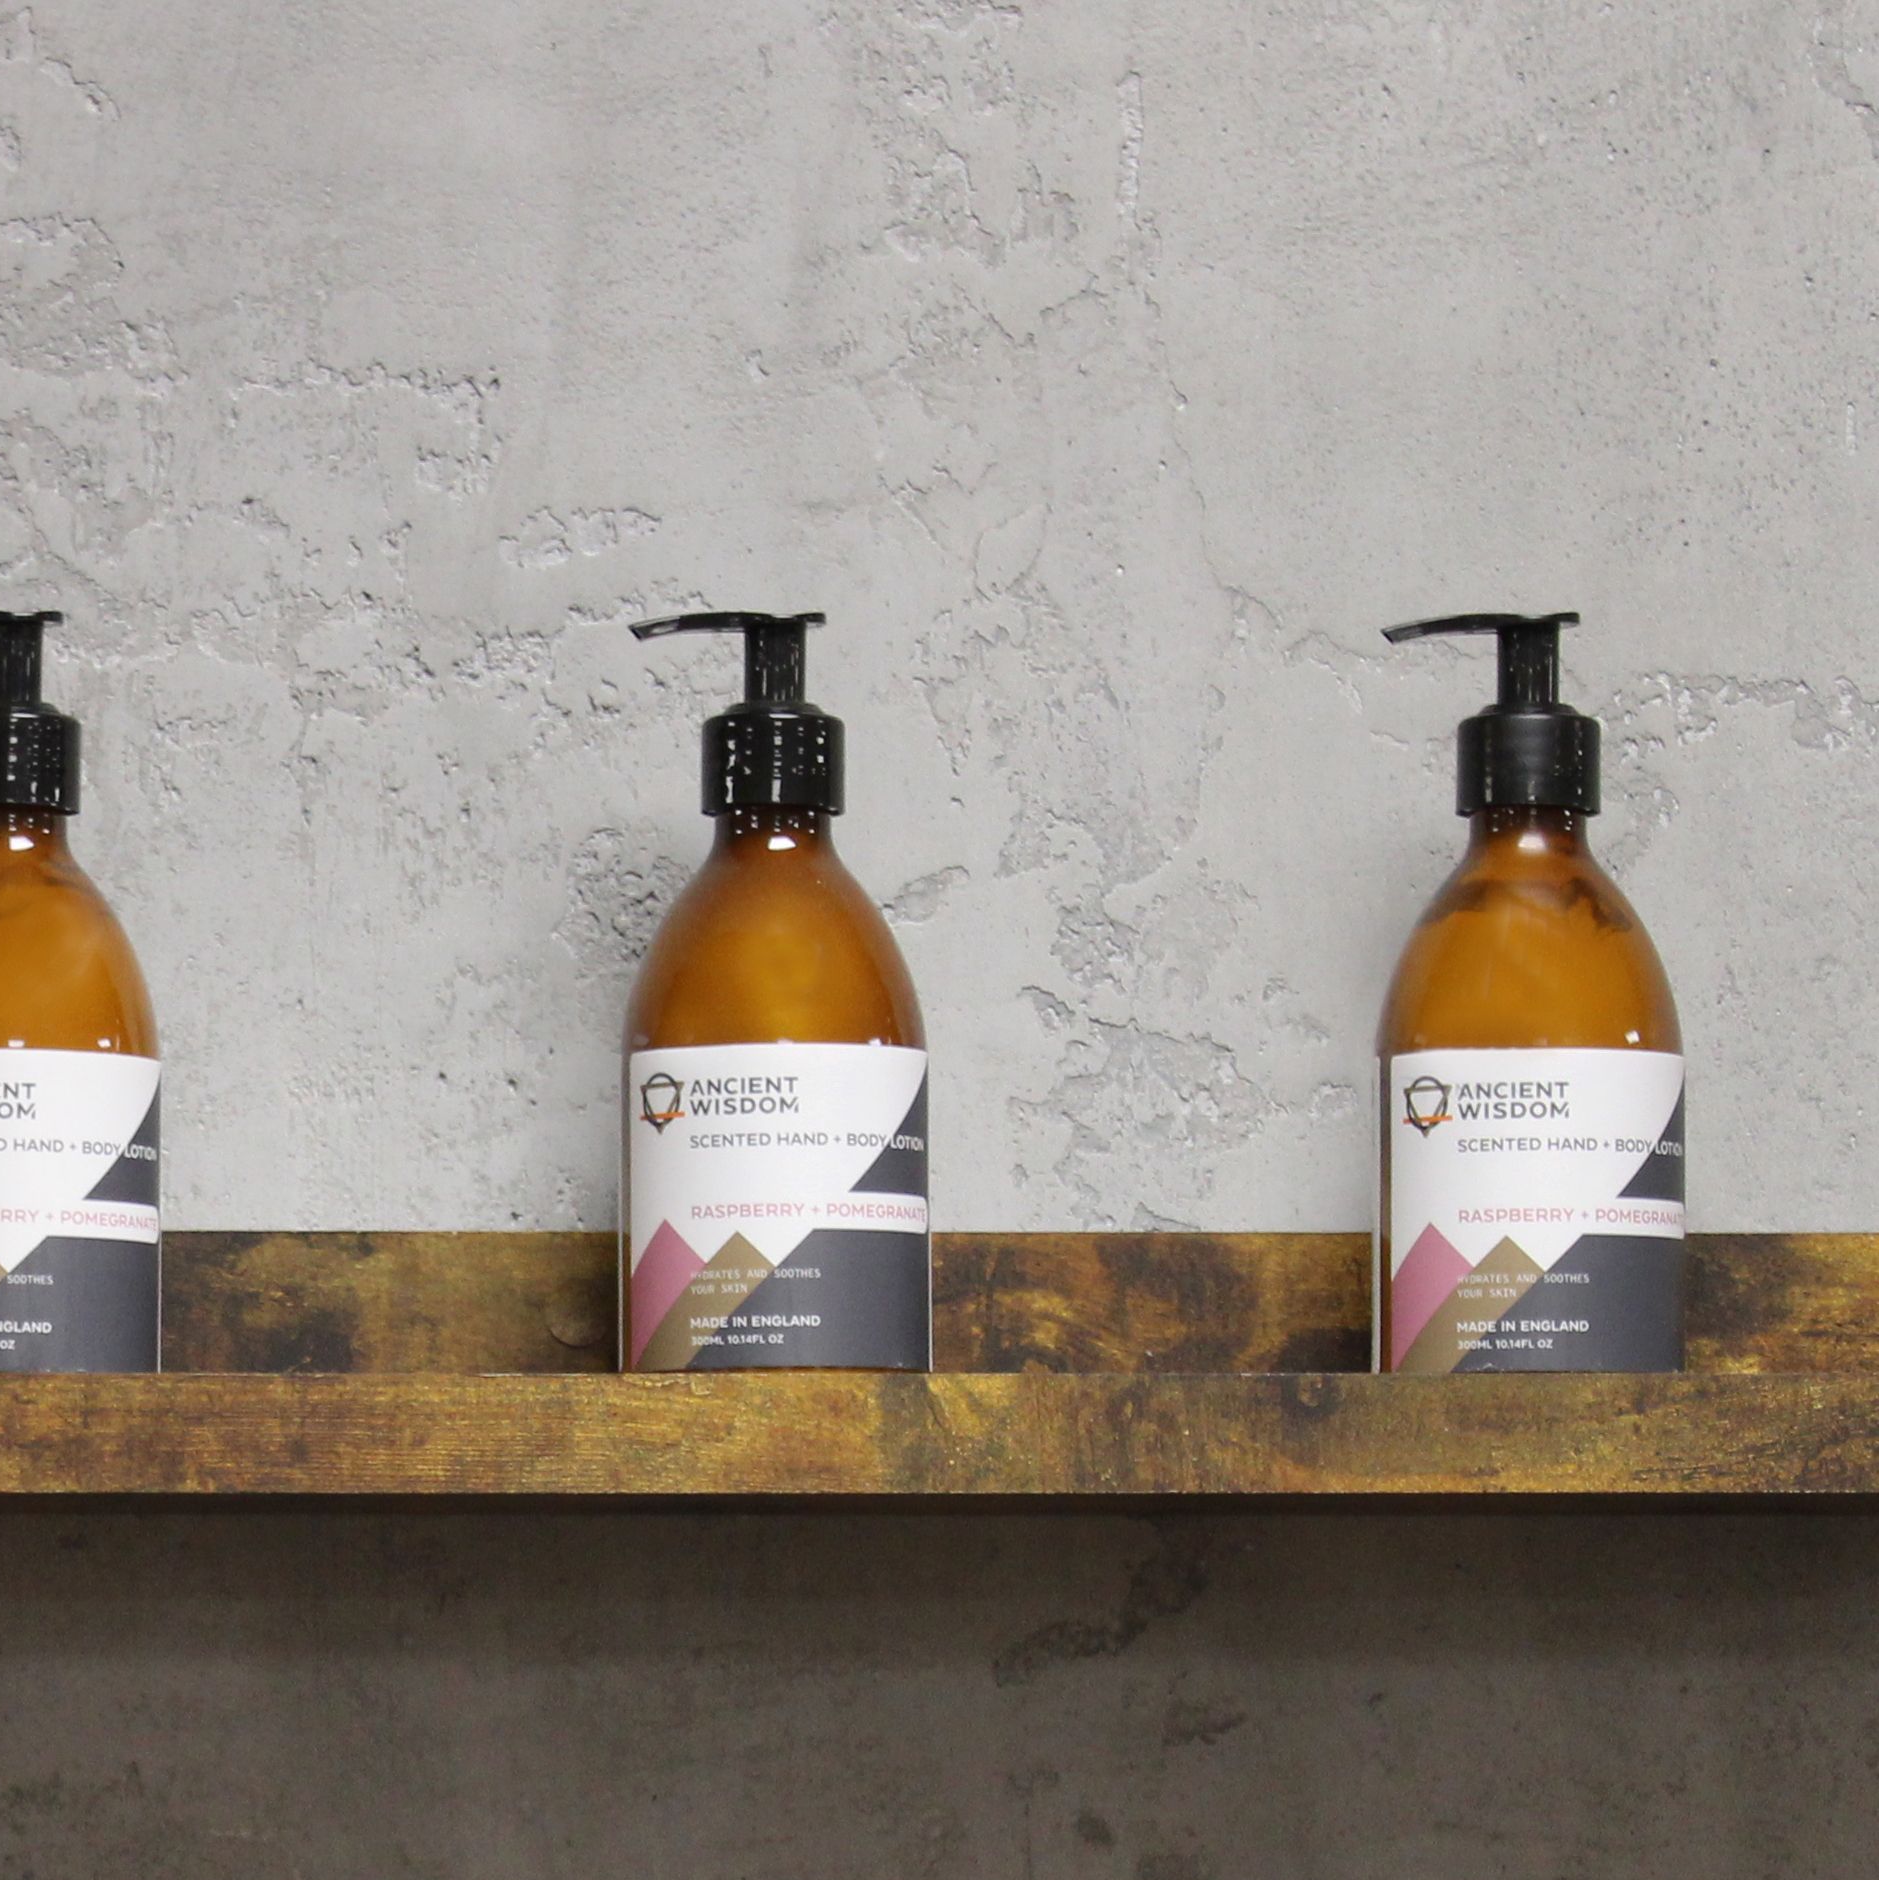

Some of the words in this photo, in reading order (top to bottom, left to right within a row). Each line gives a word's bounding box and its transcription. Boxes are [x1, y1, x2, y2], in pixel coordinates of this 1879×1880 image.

[691, 1077, 799, 1095] ANCIENT
[1458, 1082, 1569, 1100] ANCIENT
[691, 1097, 799, 1116] WISDOM
[1458, 1102, 1569, 1120] WISDOM
[690, 1134, 770, 1149] SCENTED
[777, 1133, 828, 1146] HAND
[847, 1134, 886, 1147] BODY
[890, 1136, 924, 1151] LOTION
[1458, 1138, 1541, 1153] SCENTED
[1548, 1138, 1597, 1151] HAND
[1616, 1139, 1653, 1153] BODY
[14, 1139, 64, 1152] HAND
[82, 1141, 122, 1155] BODY
[124, 1144, 156, 1161] LOTION
[692, 1203, 805, 1220] RASPBERRY
[827, 1204, 926, 1223] POMEGRANATE
[1459, 1209, 1573, 1223] RASPBERRY
[61, 1211, 157, 1232] POMEGRANATE
[774, 1268, 820, 1278] SOOTHES
[1544, 1274, 1589, 1284] SOOTHES
[721, 1283, 748, 1293] SKIN
[1489, 1288, 1516, 1298] SKIN
[690, 1316, 728, 1329] MADE
[733, 1316, 747, 1327] IN
[752, 1316, 821, 1327] ENGLAND
[1457, 1321, 1496, 1333] MADE
[1501, 1321, 1515, 1332] IN
[1521, 1321, 1589, 1332] ENGLAND
[768, 1334, 784, 1344] OZ
[1537, 1339, 1553, 1349] OZ
